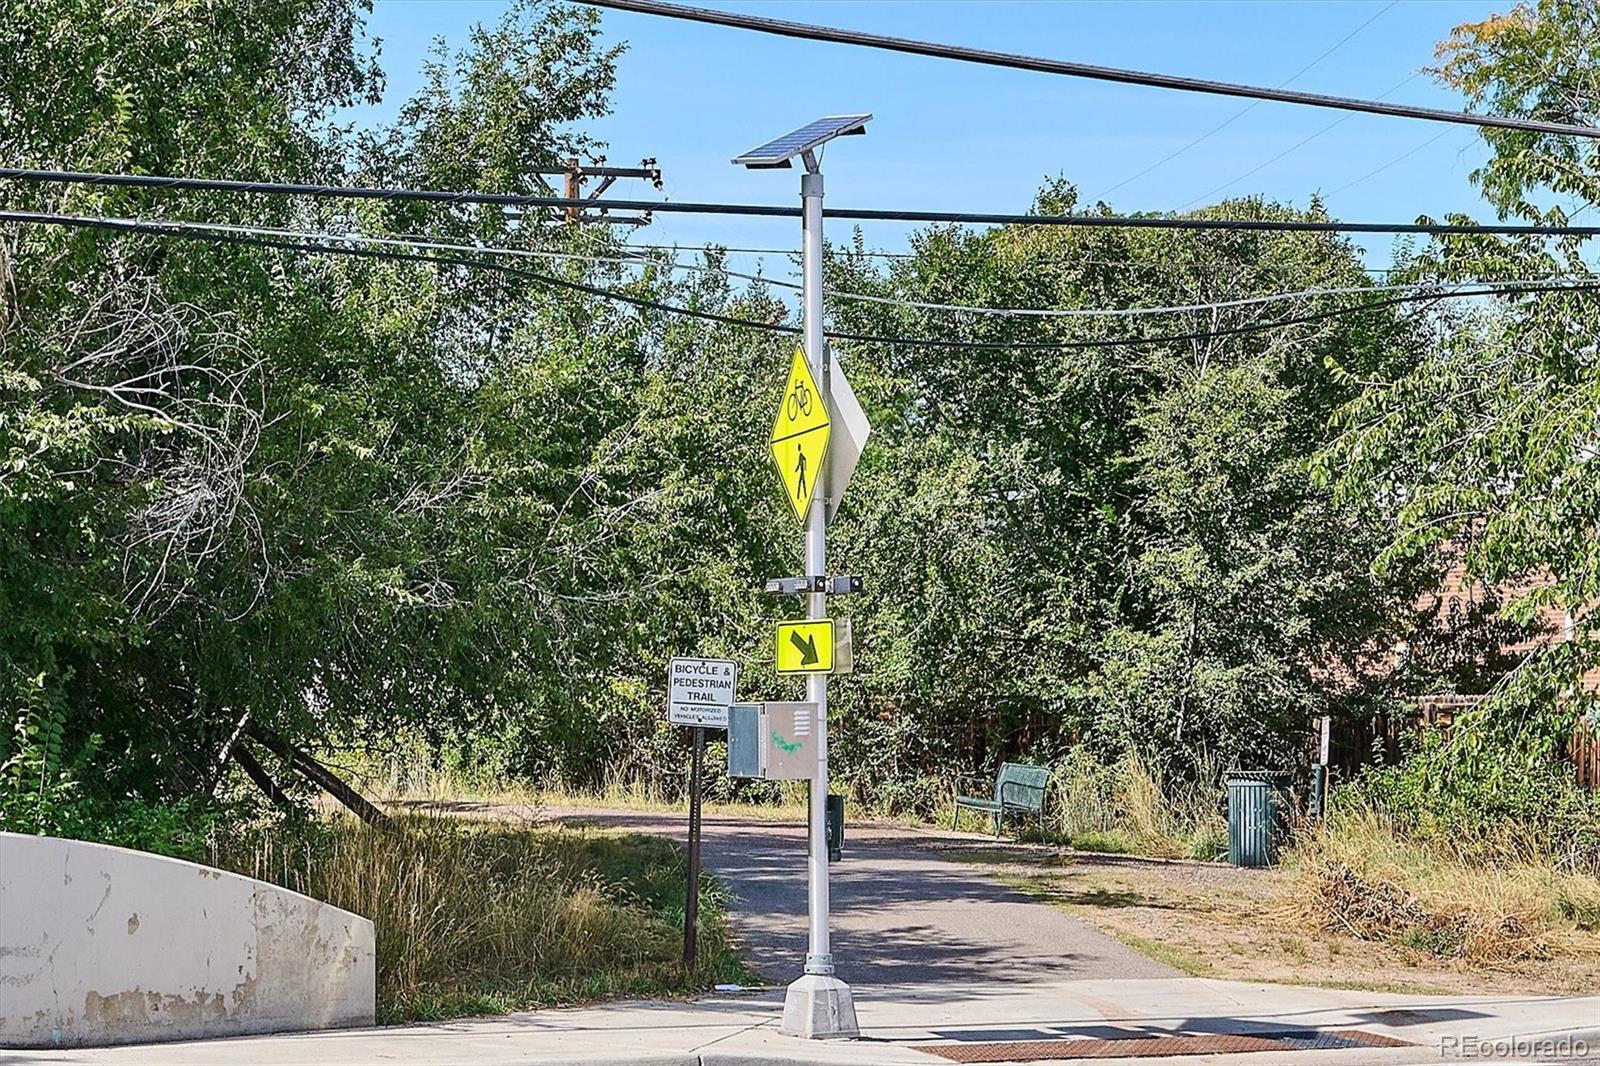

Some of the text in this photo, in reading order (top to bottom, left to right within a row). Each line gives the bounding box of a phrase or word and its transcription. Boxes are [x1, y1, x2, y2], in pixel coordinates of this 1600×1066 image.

[675, 664, 730, 676] BICYCLE &
[674, 677, 731, 688] PEDESTRIAN
[687, 692, 716, 701] TRAIL
